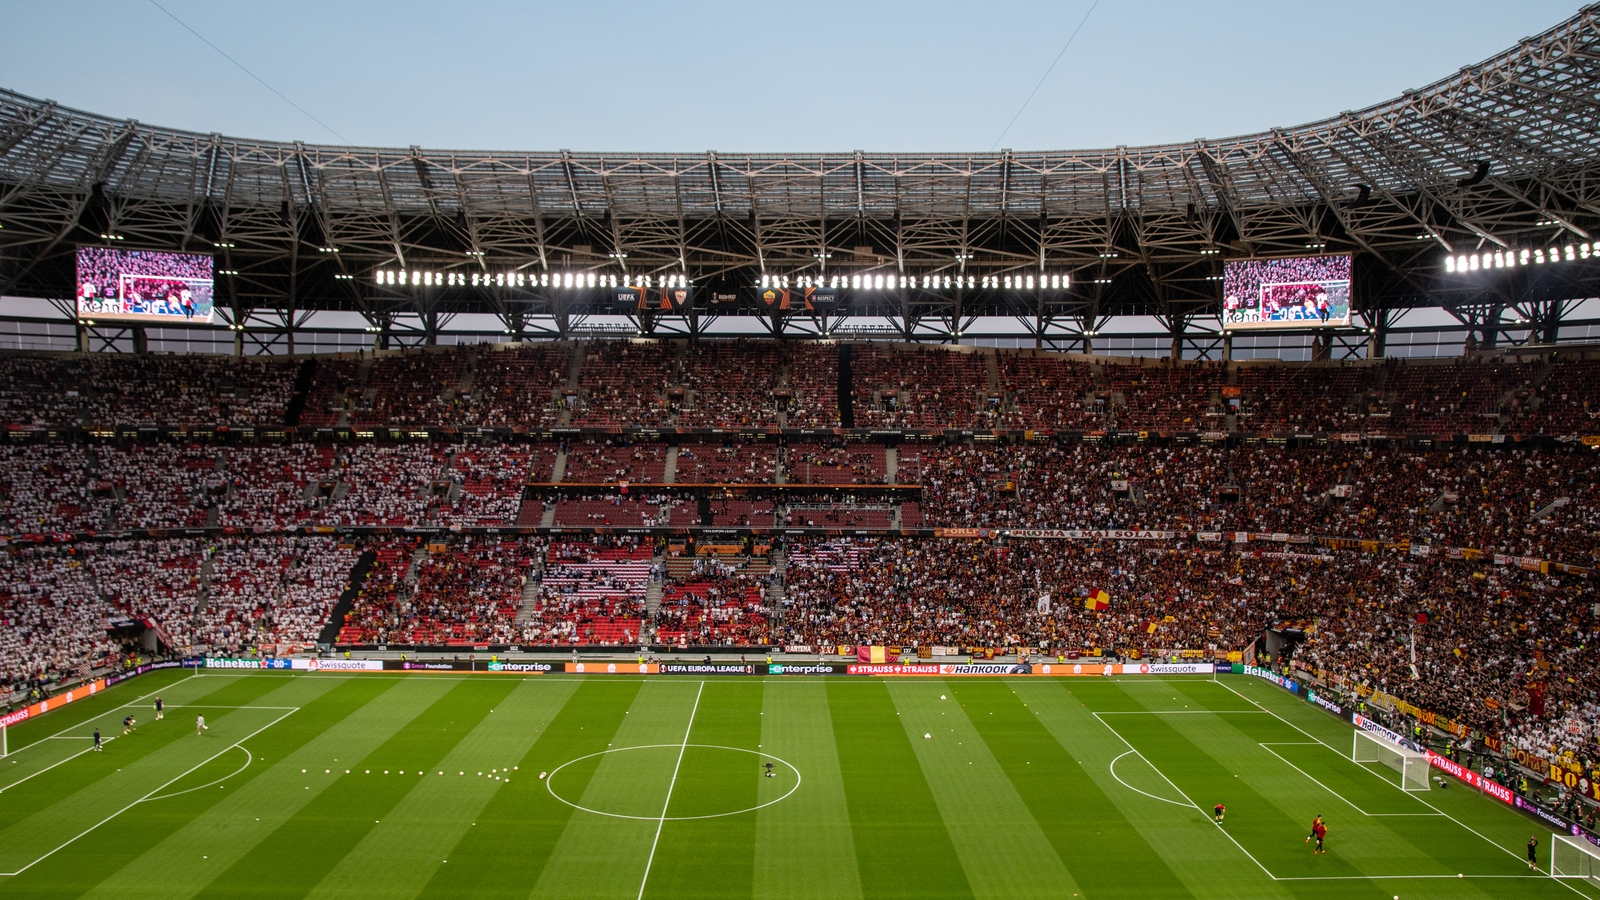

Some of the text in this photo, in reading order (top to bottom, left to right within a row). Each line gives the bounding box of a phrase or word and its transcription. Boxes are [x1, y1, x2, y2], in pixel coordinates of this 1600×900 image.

[151, 661, 181, 669] Foundation
[206, 658, 258, 668] Heineken
[319, 659, 366, 671] Swissquote
[491, 663, 551, 672] enterprise
[687, 665, 715, 673] EUROPA
[771, 664, 833, 674] enterprise
[858, 665, 938, 673] STRAUSS STRAUSS
[1150, 664, 1196, 674] Swissquote
[1243, 664, 1280, 684] Heineken
[1309, 692, 1341, 714] enterprise
[0, 712, 29, 728] STRAUSS
[1433, 755, 1510, 802] STRAUSS STRAUSS
[1536, 808, 1567, 829] Foundation
